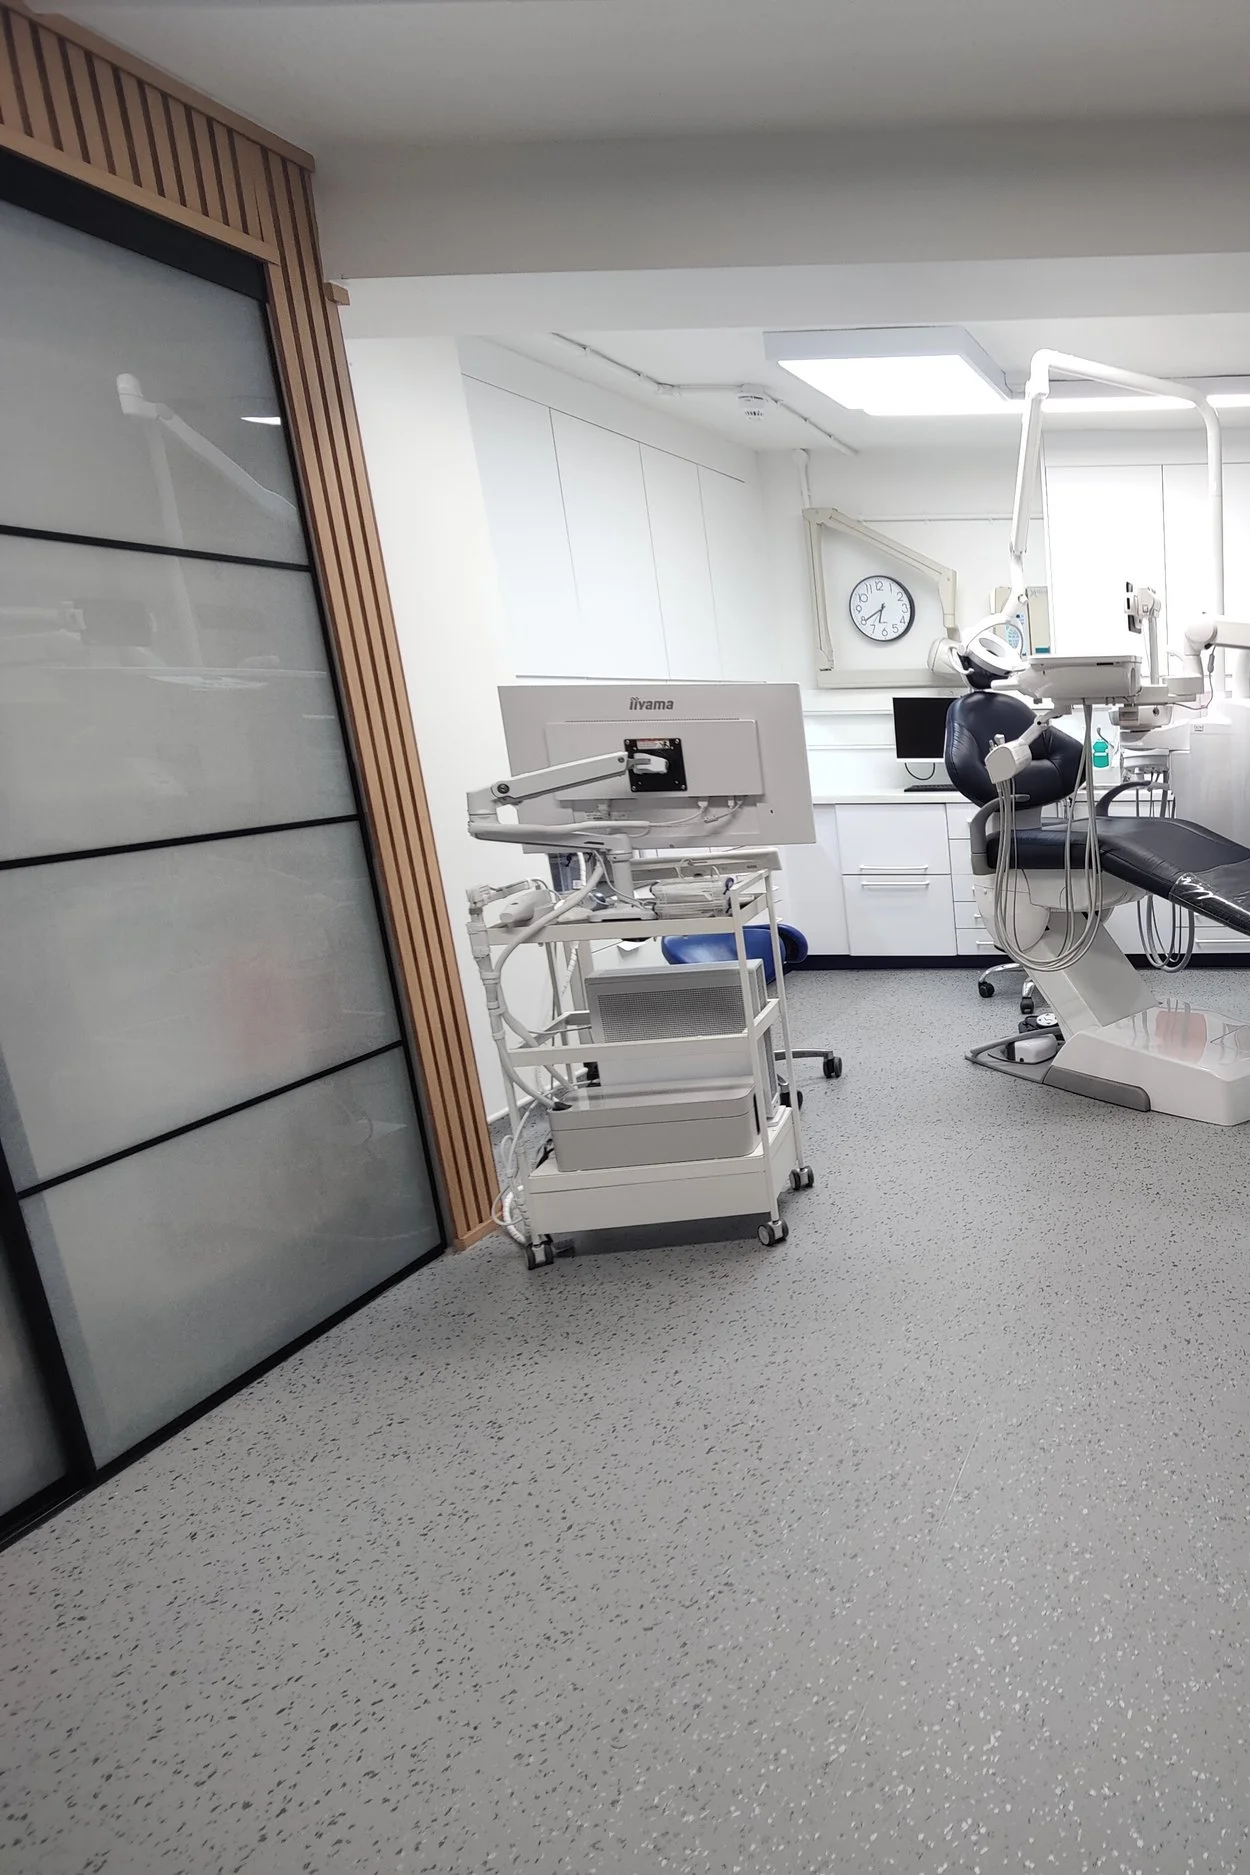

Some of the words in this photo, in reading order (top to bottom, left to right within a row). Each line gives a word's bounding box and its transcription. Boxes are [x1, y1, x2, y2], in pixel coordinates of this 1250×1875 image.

[864, 582, 873, 594] 11
[875, 580, 884, 591] 12
[857, 592, 869, 603] 10
[897, 592, 903, 602] 2
[856, 605, 862, 614] 9
[902, 603, 908, 613] 3
[860, 616, 868, 626] 8
[899, 615, 906, 625] 4
[869, 623, 876, 634] 7
[882, 628, 888, 636] 6
[892, 624, 899, 633] 5
[629, 696, 674, 710] iiyama
